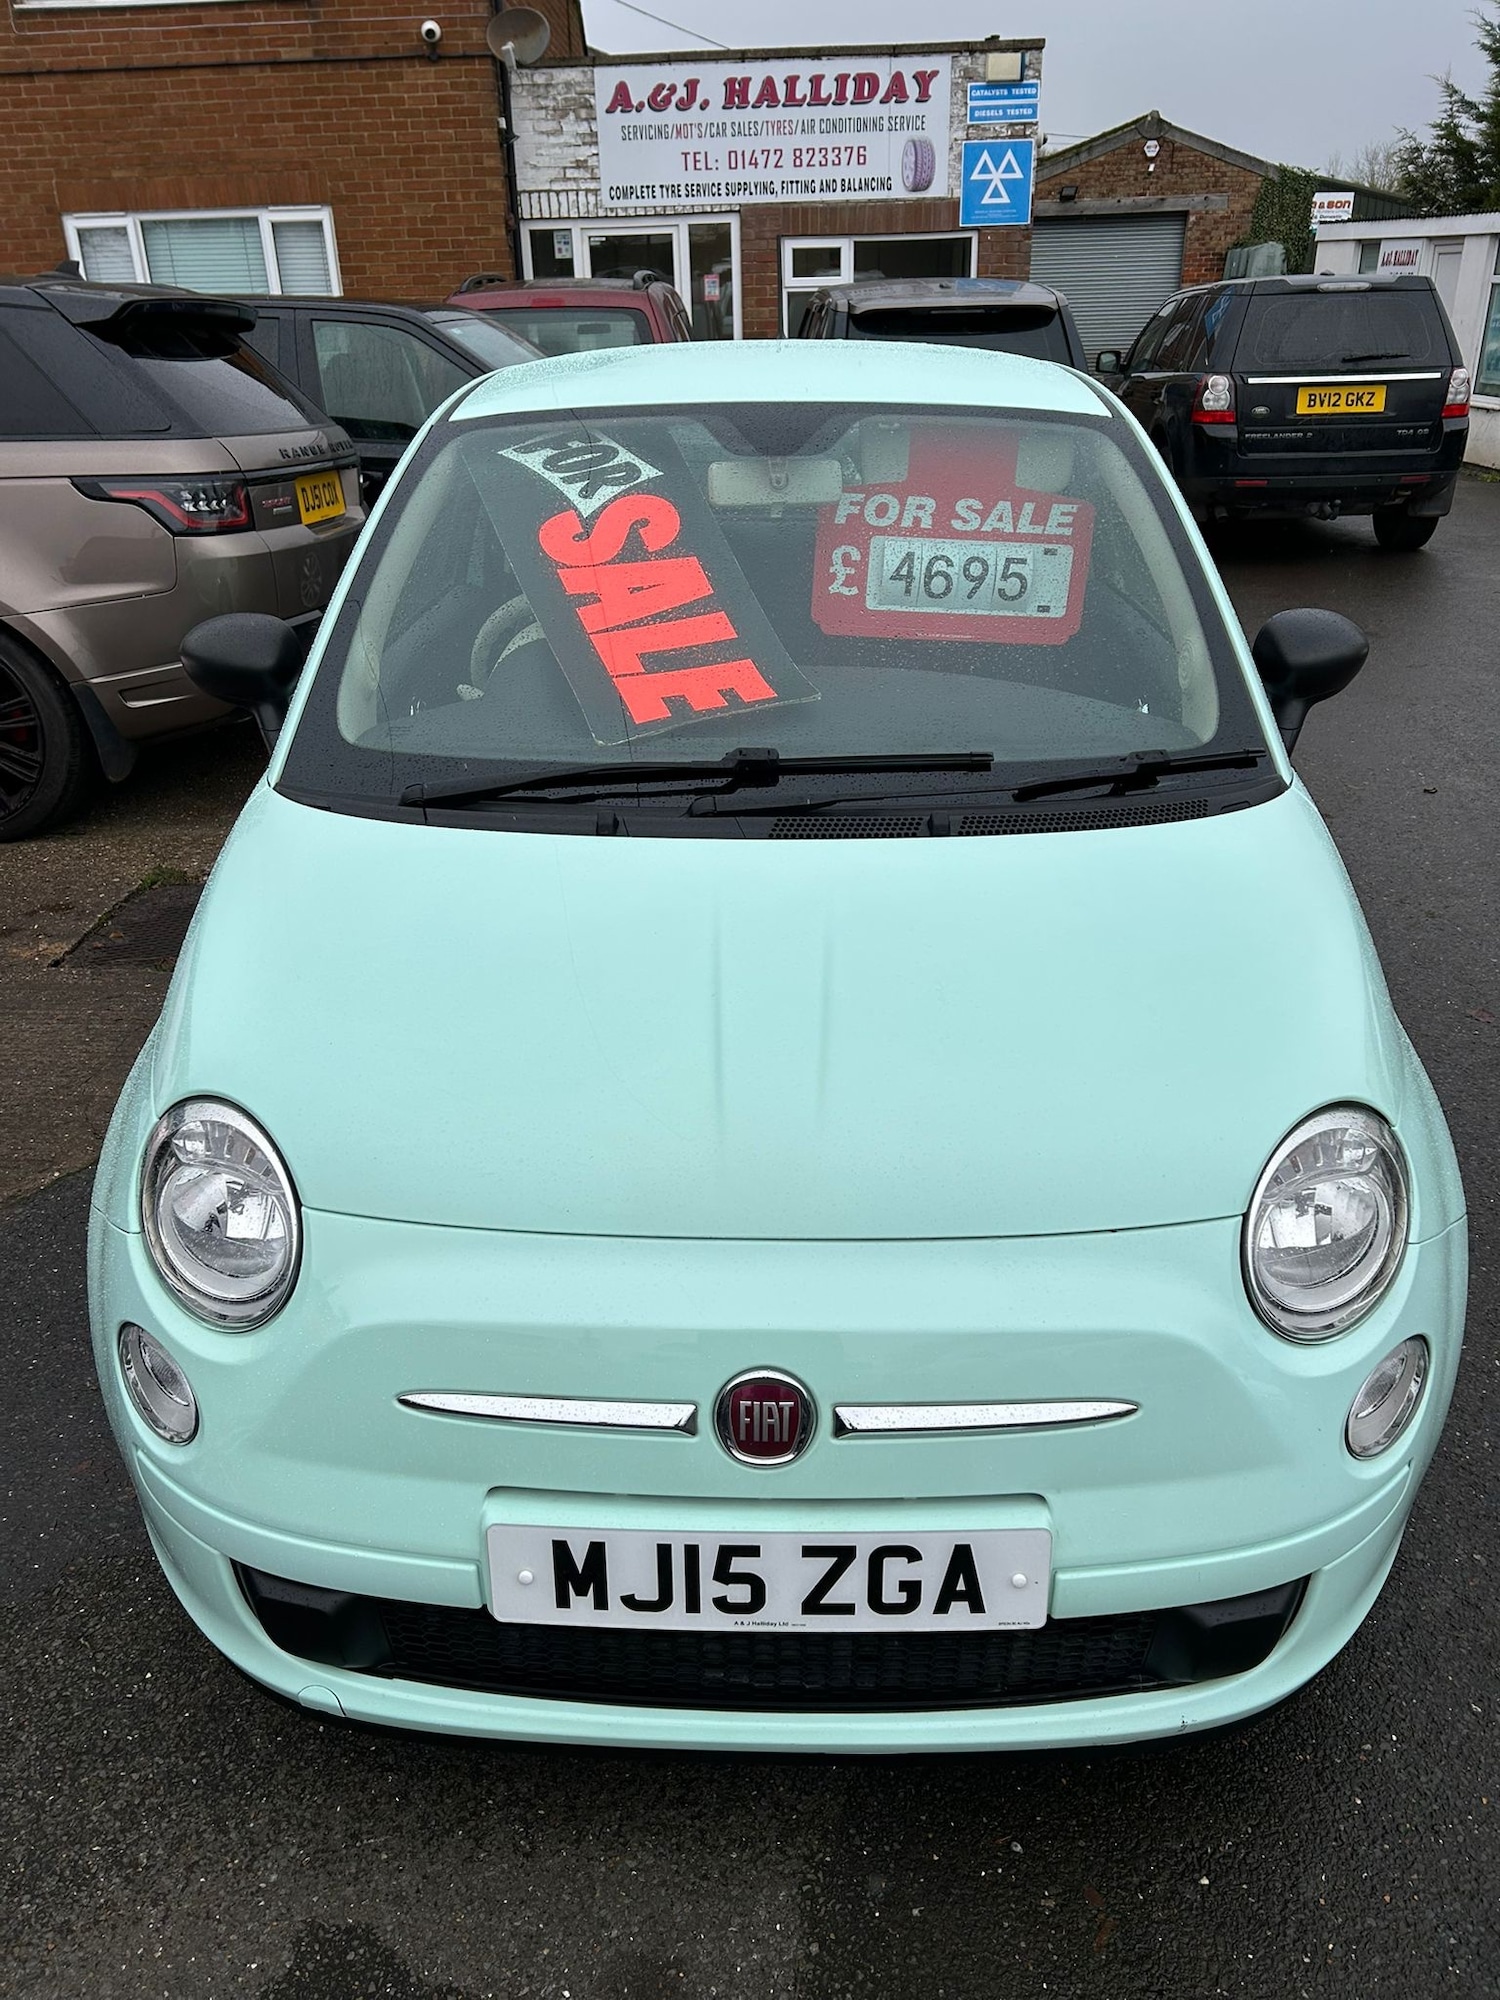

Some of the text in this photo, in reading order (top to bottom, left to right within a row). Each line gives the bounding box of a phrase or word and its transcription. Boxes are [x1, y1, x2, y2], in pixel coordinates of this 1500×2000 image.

[722, 70, 940, 110] HALLIDAY
[971, 87, 1037, 97] CATALYSTS TESTED
[819, 116, 884, 134] CONDITIONING
[887, 115, 926, 132] SERVICE
[974, 109, 1003, 117] DIESELS
[681, 145, 867, 171] TEL: 01472 823376
[609, 176, 892, 200] COMPLETE TYRE SERVICE SUPPLYING, FITTING AND BALANCING
[1307, 391, 1376, 408] BV12 GKZ
[834, 492, 1080, 536] FOR SALE
[511, 431, 778, 725] FOR SALE
[889, 551, 1029, 602] 4695
[739, 1400, 795, 1442] FIAT
[552, 1539, 987, 1616] MJ15 ZGA
